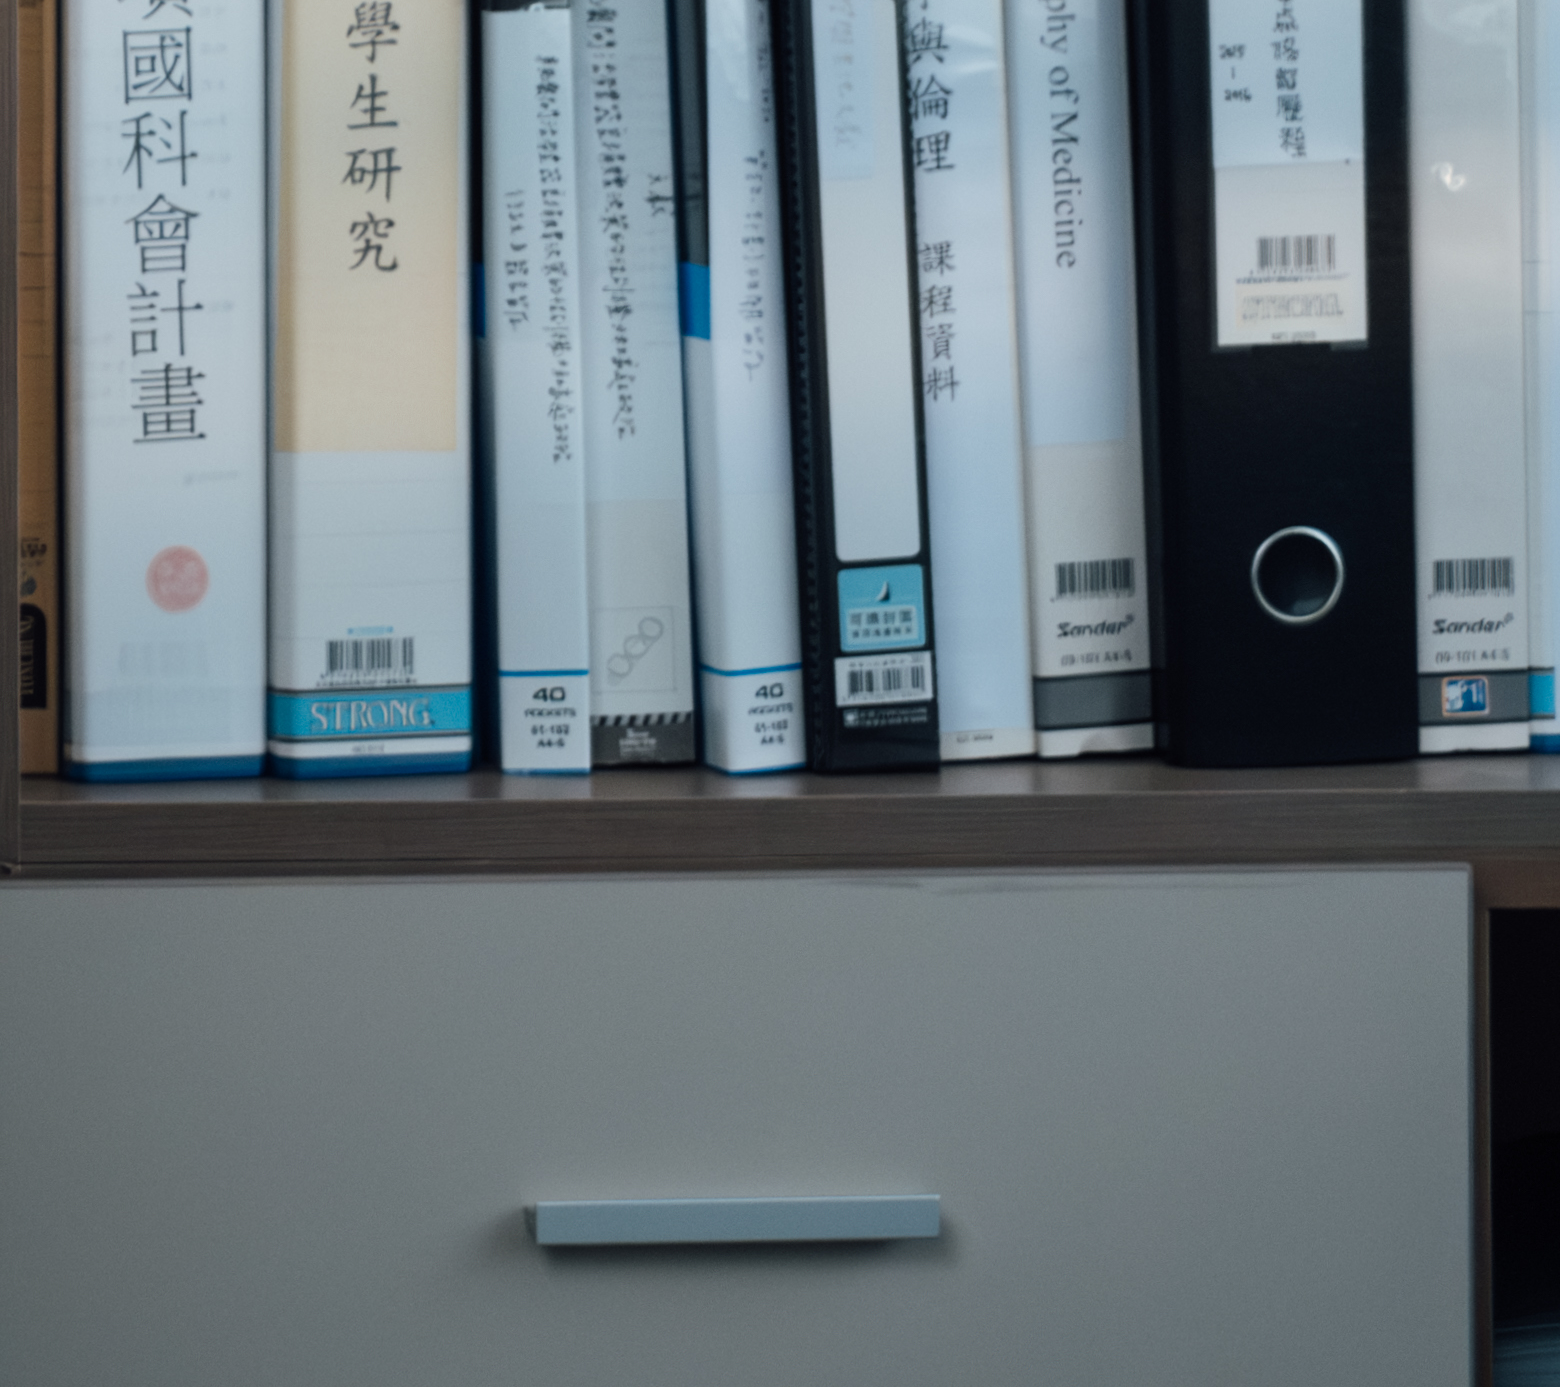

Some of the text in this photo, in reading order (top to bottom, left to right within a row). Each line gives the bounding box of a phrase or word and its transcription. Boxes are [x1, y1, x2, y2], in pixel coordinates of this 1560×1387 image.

[1048, 65, 1081, 104] of
[1050, 111, 1084, 269] Medicine
[918, 239, 960, 403] 課程資料
[532, 686, 566, 703] 40
[754, 682, 784, 699] 40
[311, 697, 430, 731] STRONG
